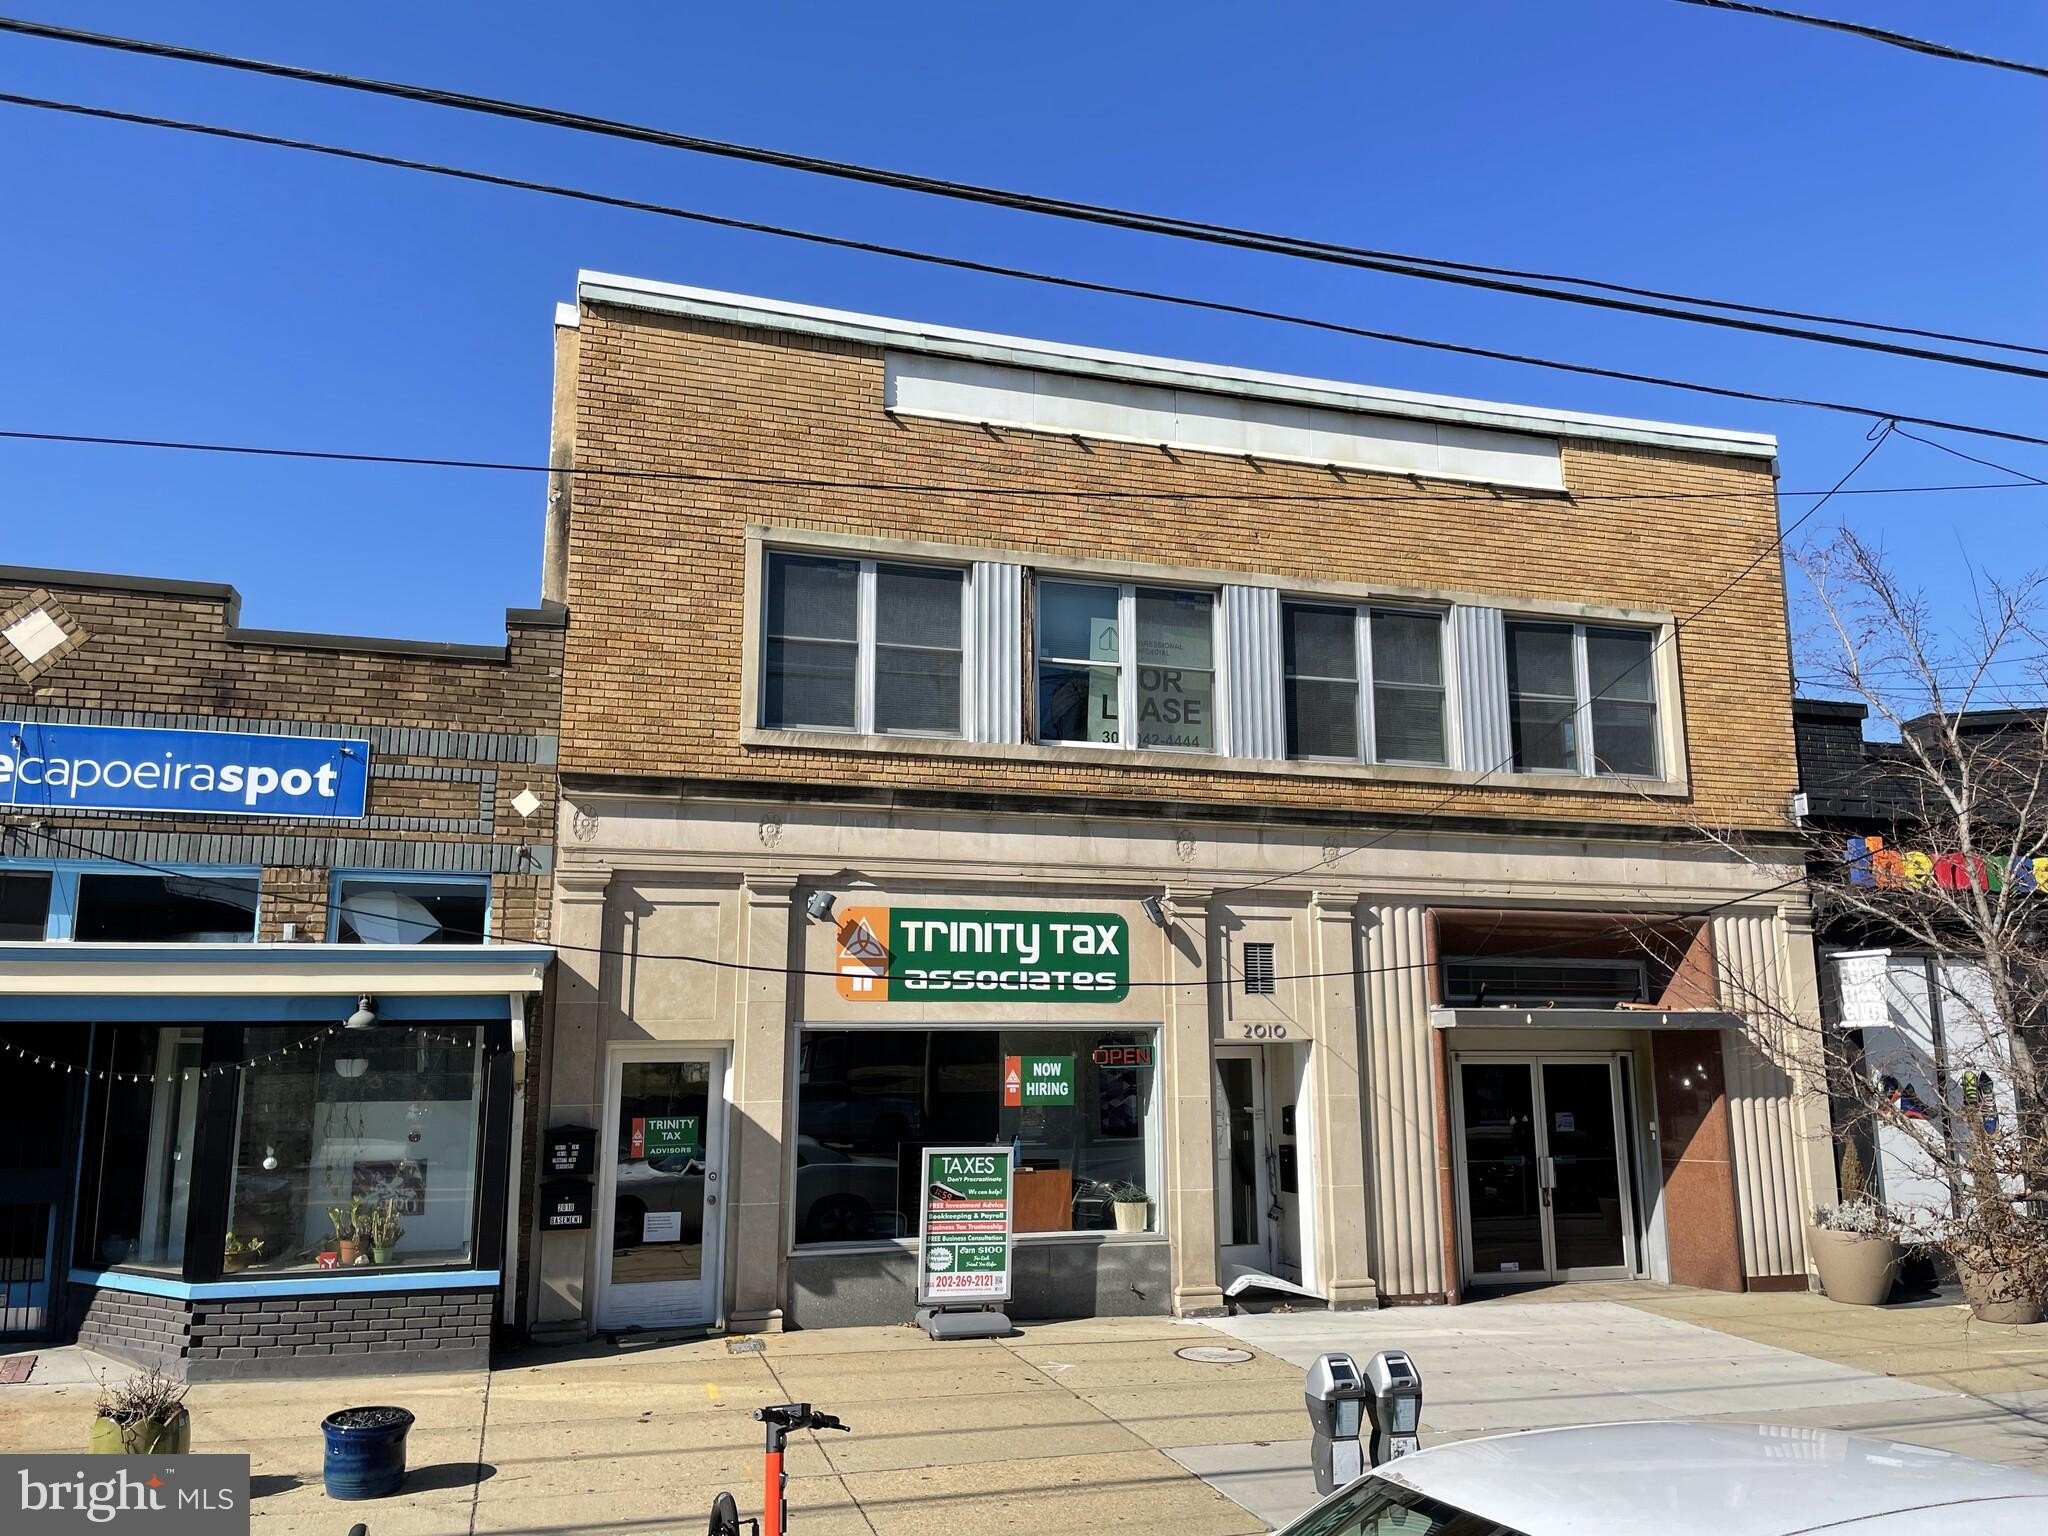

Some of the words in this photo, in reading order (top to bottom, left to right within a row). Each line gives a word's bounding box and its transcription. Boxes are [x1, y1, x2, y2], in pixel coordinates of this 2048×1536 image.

[1139, 668, 1183, 693] OR
[1102, 694, 1201, 724] LASE
[1243, 1024, 1287, 1039] 2010
[1094, 1048, 1151, 1065] OPEN
[1033, 1063, 1061, 1077] NOW
[1026, 1082, 1069, 1096] HIRING
[648, 1119, 695, 1130] TRINITY
[662, 1131, 681, 1140] TAX
[650, 1147, 692, 1155] ADVISORS
[942, 1157, 995, 1174] TAXES
[550, 1215, 583, 1225] BASEMENT
[936, 1275, 993, 1287] 202-269-2121
